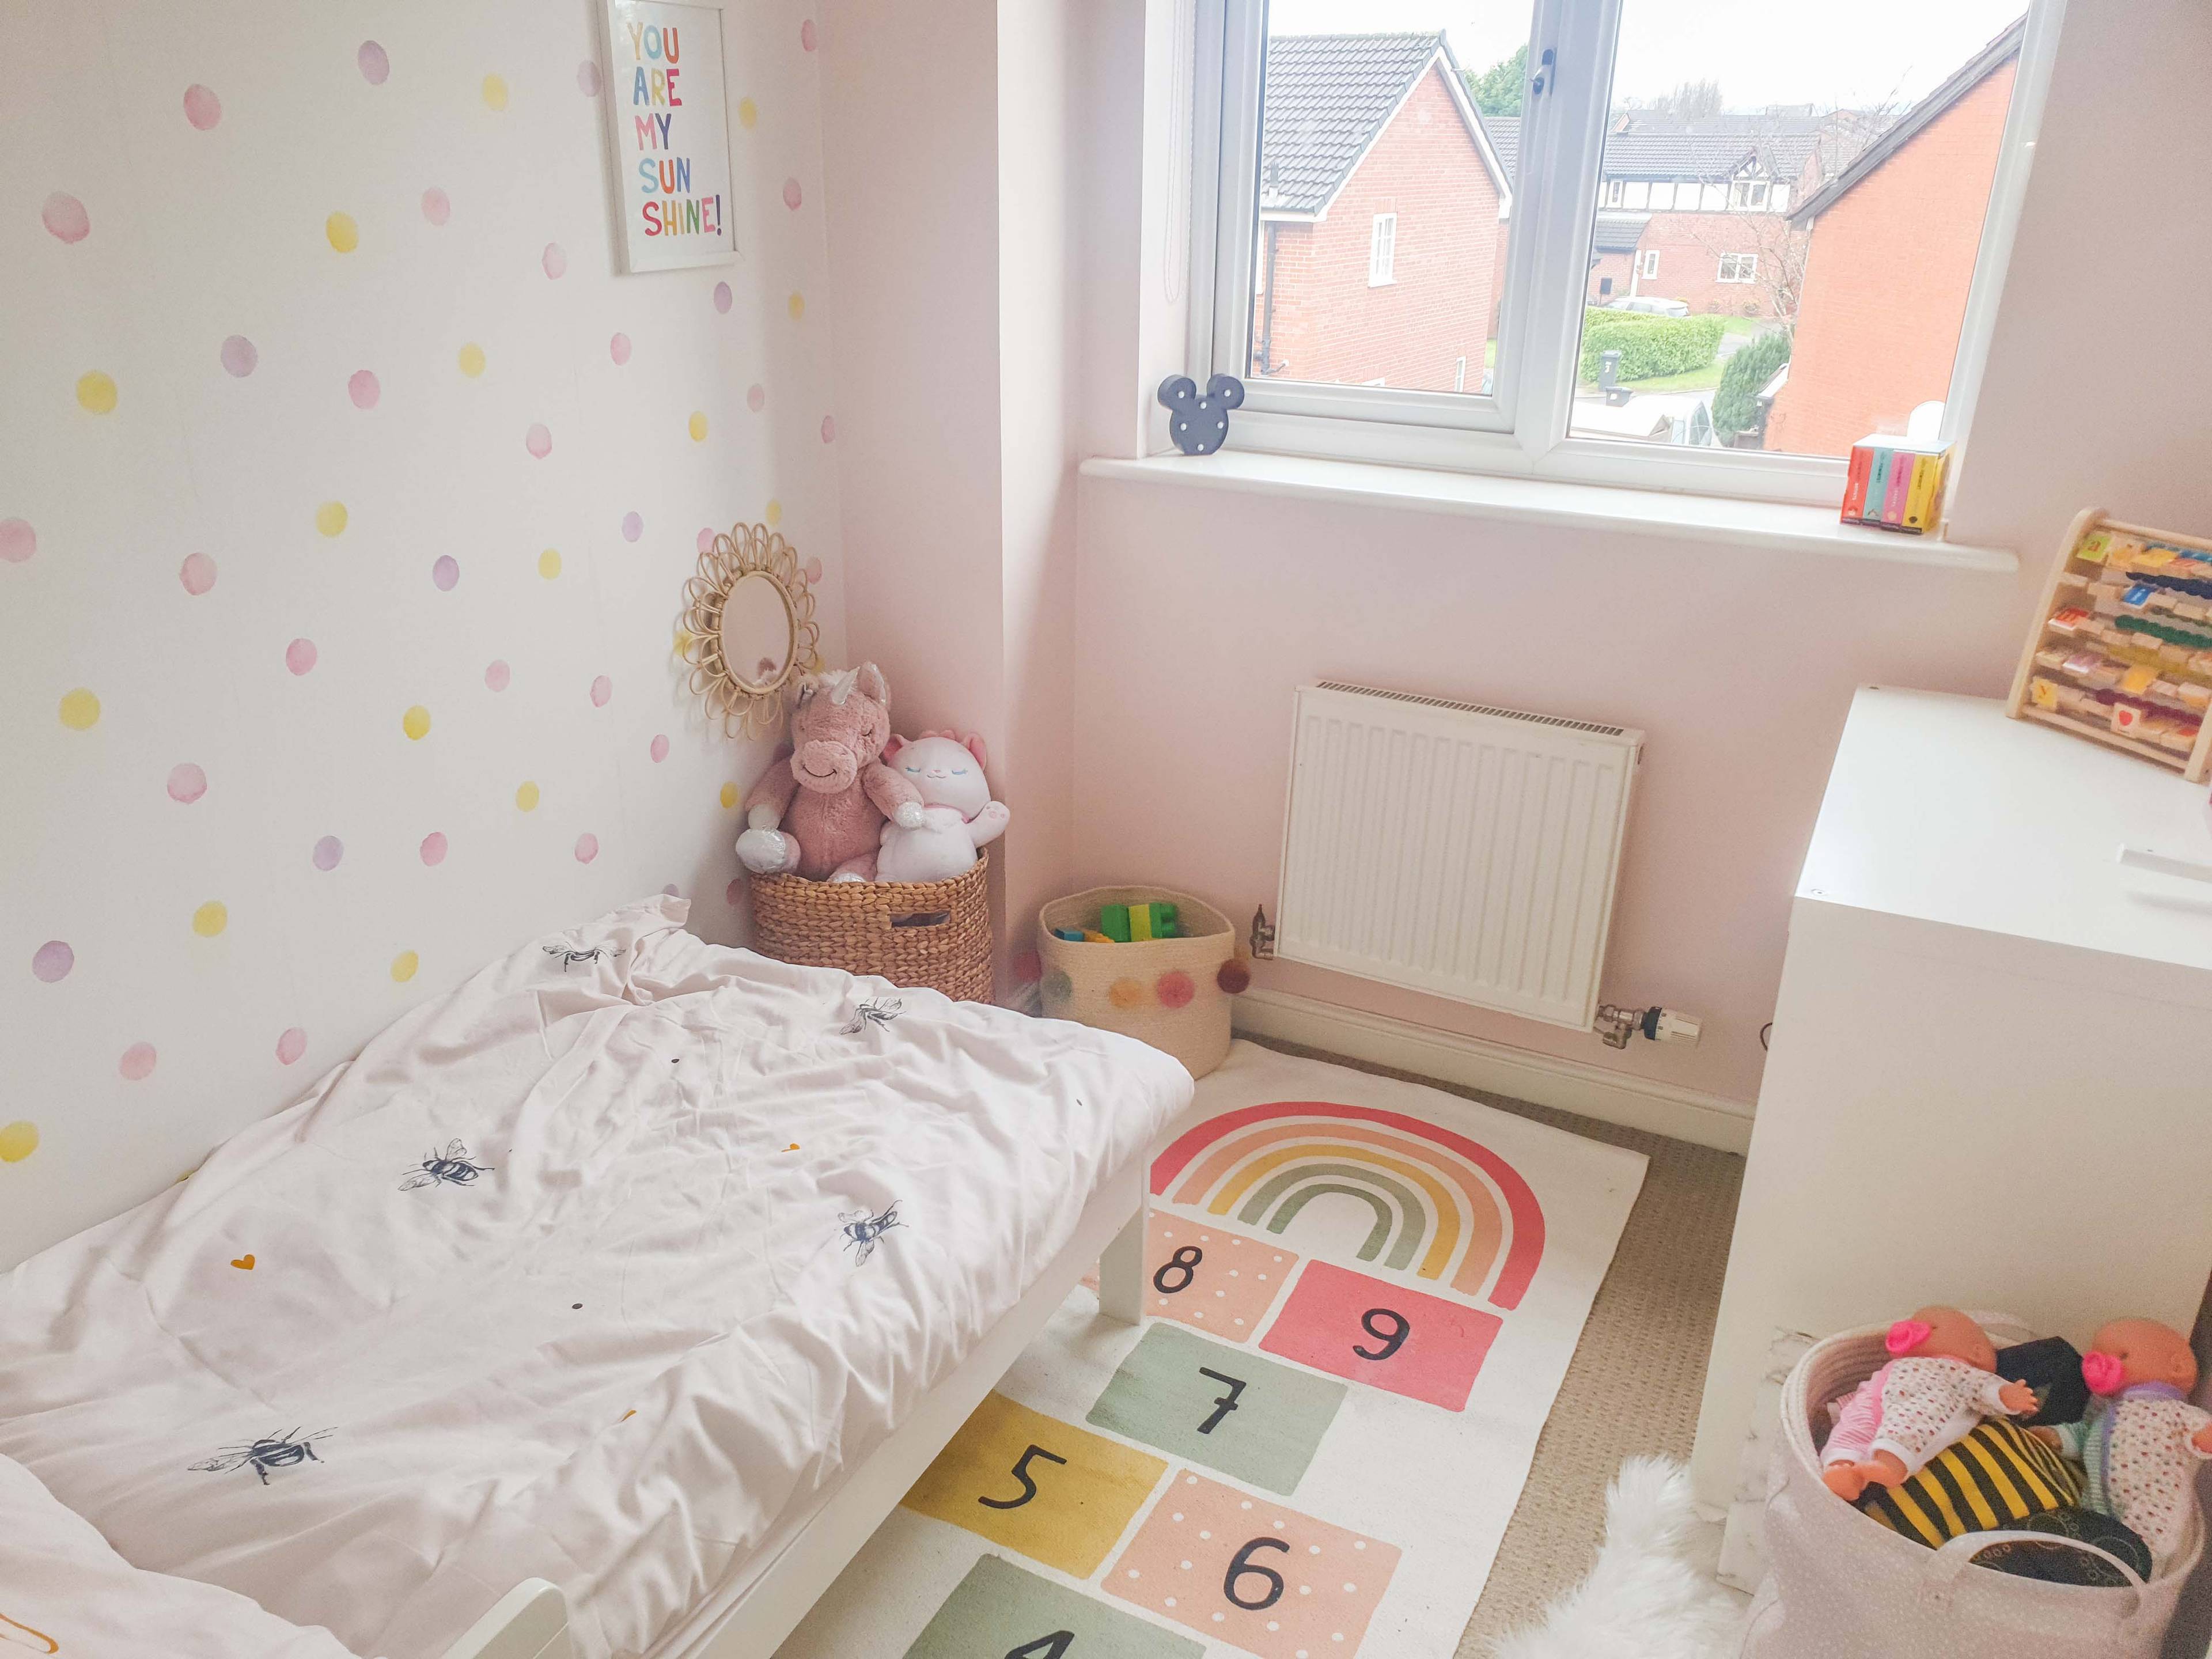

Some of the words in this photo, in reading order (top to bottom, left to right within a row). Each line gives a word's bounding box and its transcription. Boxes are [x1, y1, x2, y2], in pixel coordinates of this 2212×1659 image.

[627, 22, 680, 64] YOU
[634, 66, 682, 107] ARE
[635, 113, 672, 150] MY
[638, 157, 690, 194] SUN
[642, 194, 722, 237] SHINE!
[1153, 1246, 1203, 1294] 8
[1353, 1308, 1411, 1361] 9
[1197, 1367, 1247, 1434] 7
[978, 1444, 1067, 1509] 5
[1224, 1537, 1290, 1611] 6
